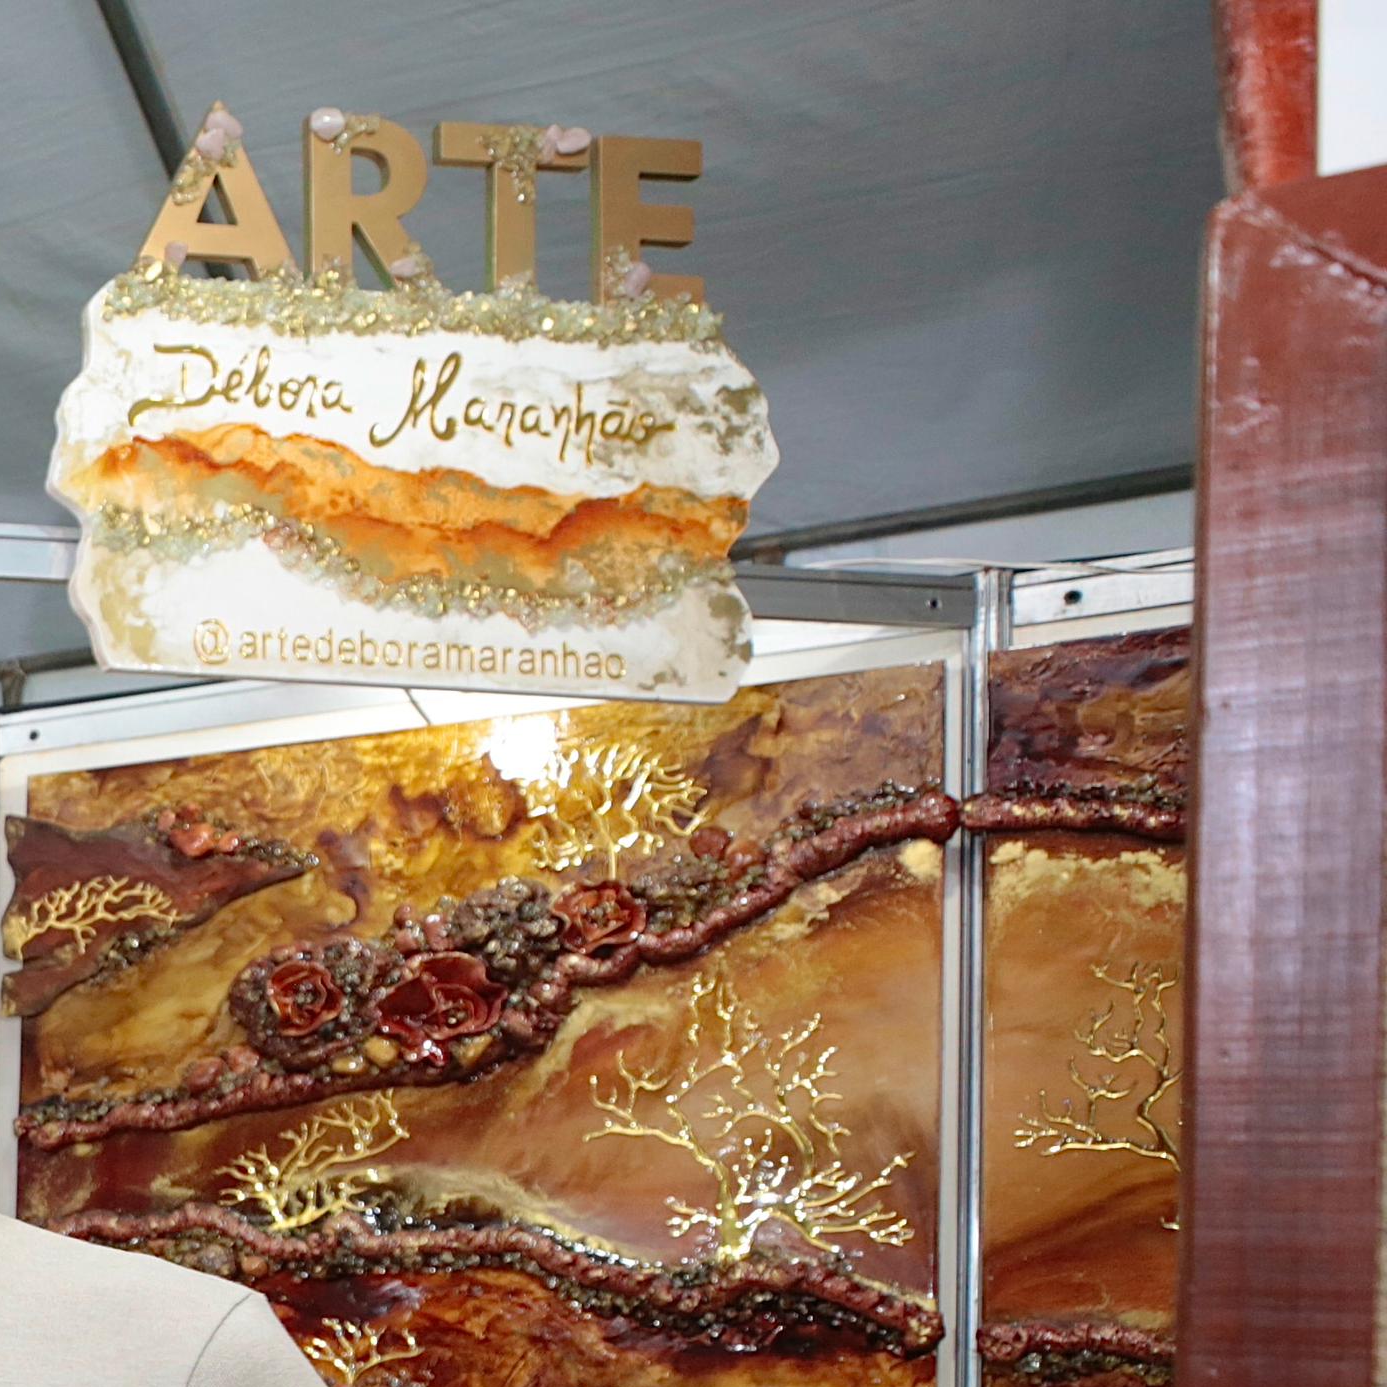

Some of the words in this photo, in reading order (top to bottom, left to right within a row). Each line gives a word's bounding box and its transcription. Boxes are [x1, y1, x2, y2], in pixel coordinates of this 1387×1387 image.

[133, 100, 704, 306] ARTE
[128, 344, 354, 428] Débora
[369, 352, 676, 466] Maranhão
[193, 619, 626, 680] @artedeboramaranhao
